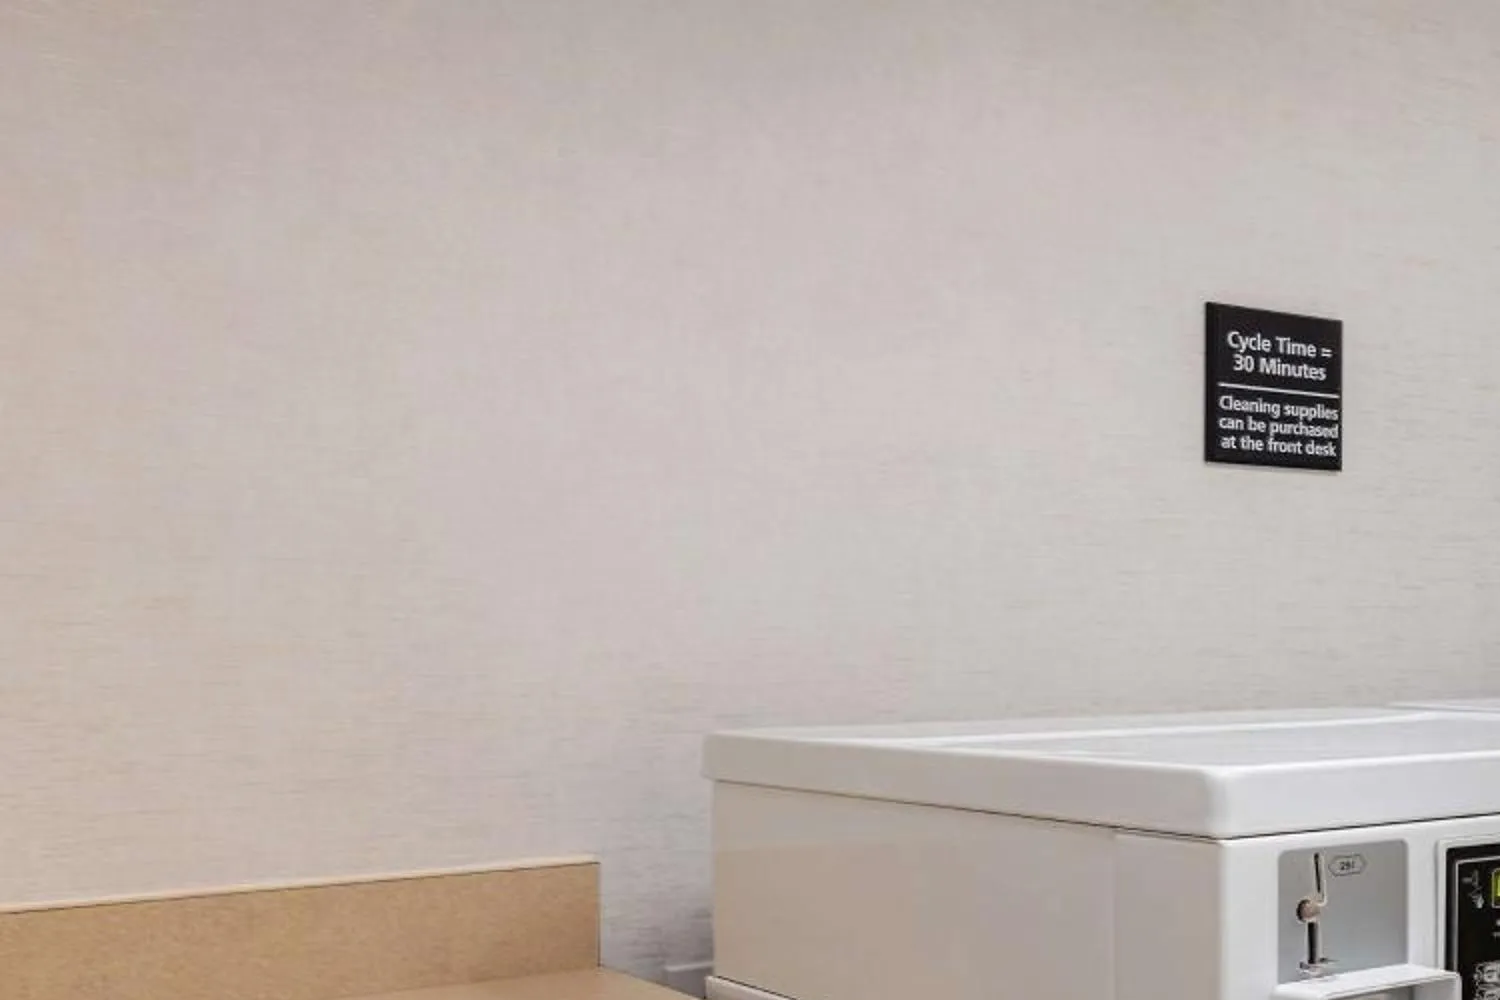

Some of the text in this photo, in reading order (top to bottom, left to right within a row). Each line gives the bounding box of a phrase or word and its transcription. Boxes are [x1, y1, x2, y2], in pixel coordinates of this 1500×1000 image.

[1227, 331, 1333, 358] Cycle Time =
[1233, 354, 1327, 381] 30 Minutes
[1219, 395, 1339, 421] Cleaning supplies
[1219, 417, 1339, 439] can be purchased
[1221, 436, 1336, 457] at the front desk
